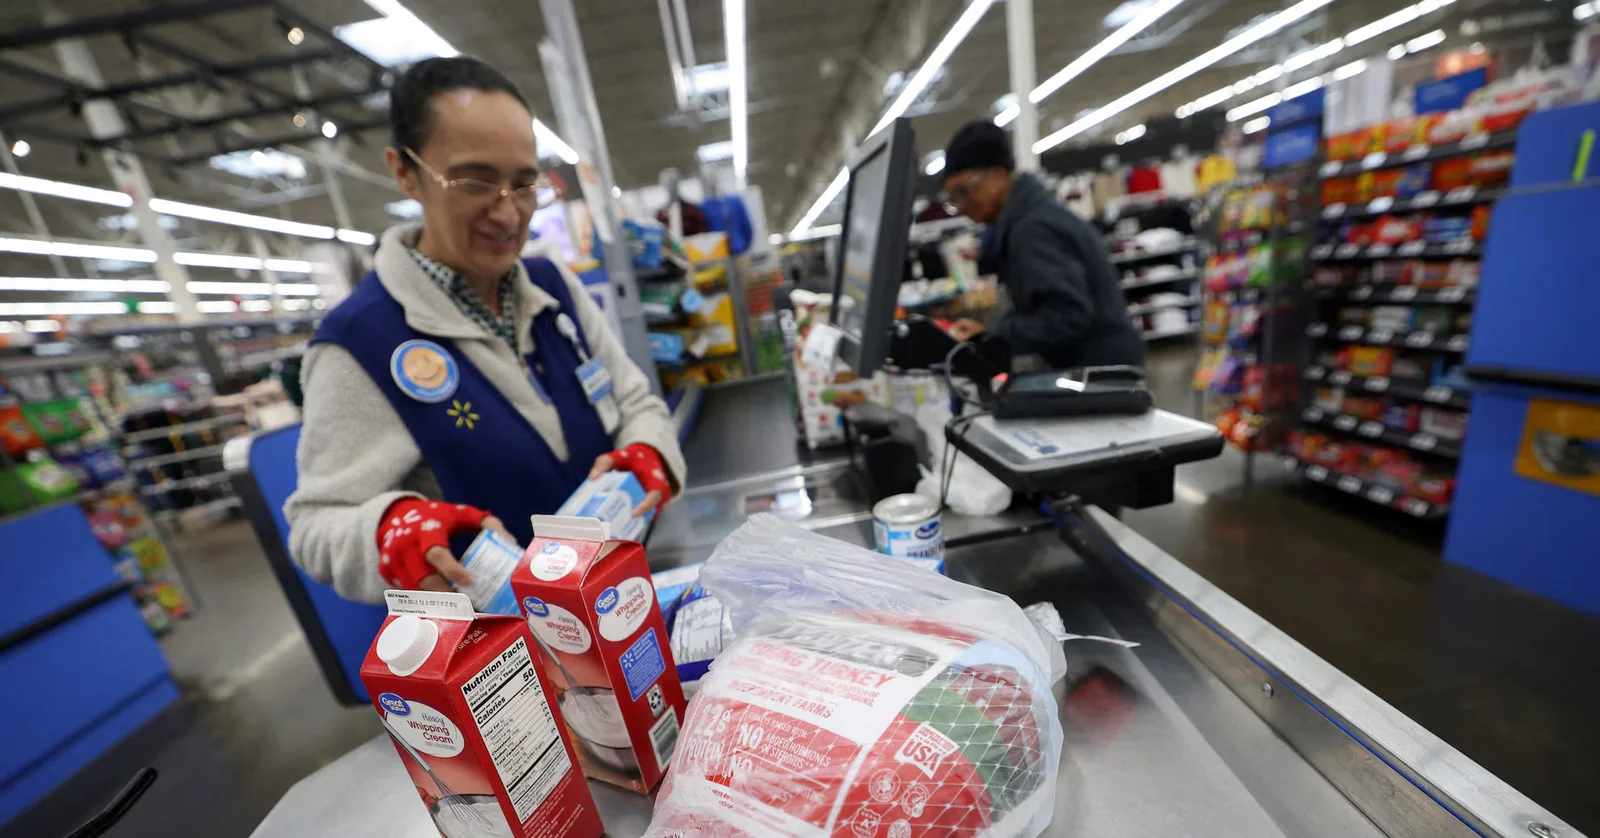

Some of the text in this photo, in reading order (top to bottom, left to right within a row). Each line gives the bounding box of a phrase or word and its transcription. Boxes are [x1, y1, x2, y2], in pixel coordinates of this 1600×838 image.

[598, 591, 615, 608] Great
[615, 591, 645, 617] Whipping
[625, 599, 647, 619] Cream
[545, 621, 580, 635] Whipping
[557, 632, 583, 643] Cream
[456, 629, 483, 651] ure-Pak
[463, 640, 523, 694] Nutrition Facts
[808, 656, 896, 688] TURKEY
[381, 697, 405, 708] Great
[470, 691, 487, 707] Serving
[487, 682, 496, 691] size
[477, 667, 534, 724] Calories 50
[407, 720, 450, 736] Whipping
[422, 713, 446, 727] Heavy
[423, 732, 454, 744] Cream
[737, 723, 764, 750] NO
[765, 733, 831, 767] ADDED HORMONES
[902, 739, 940, 772] USA
